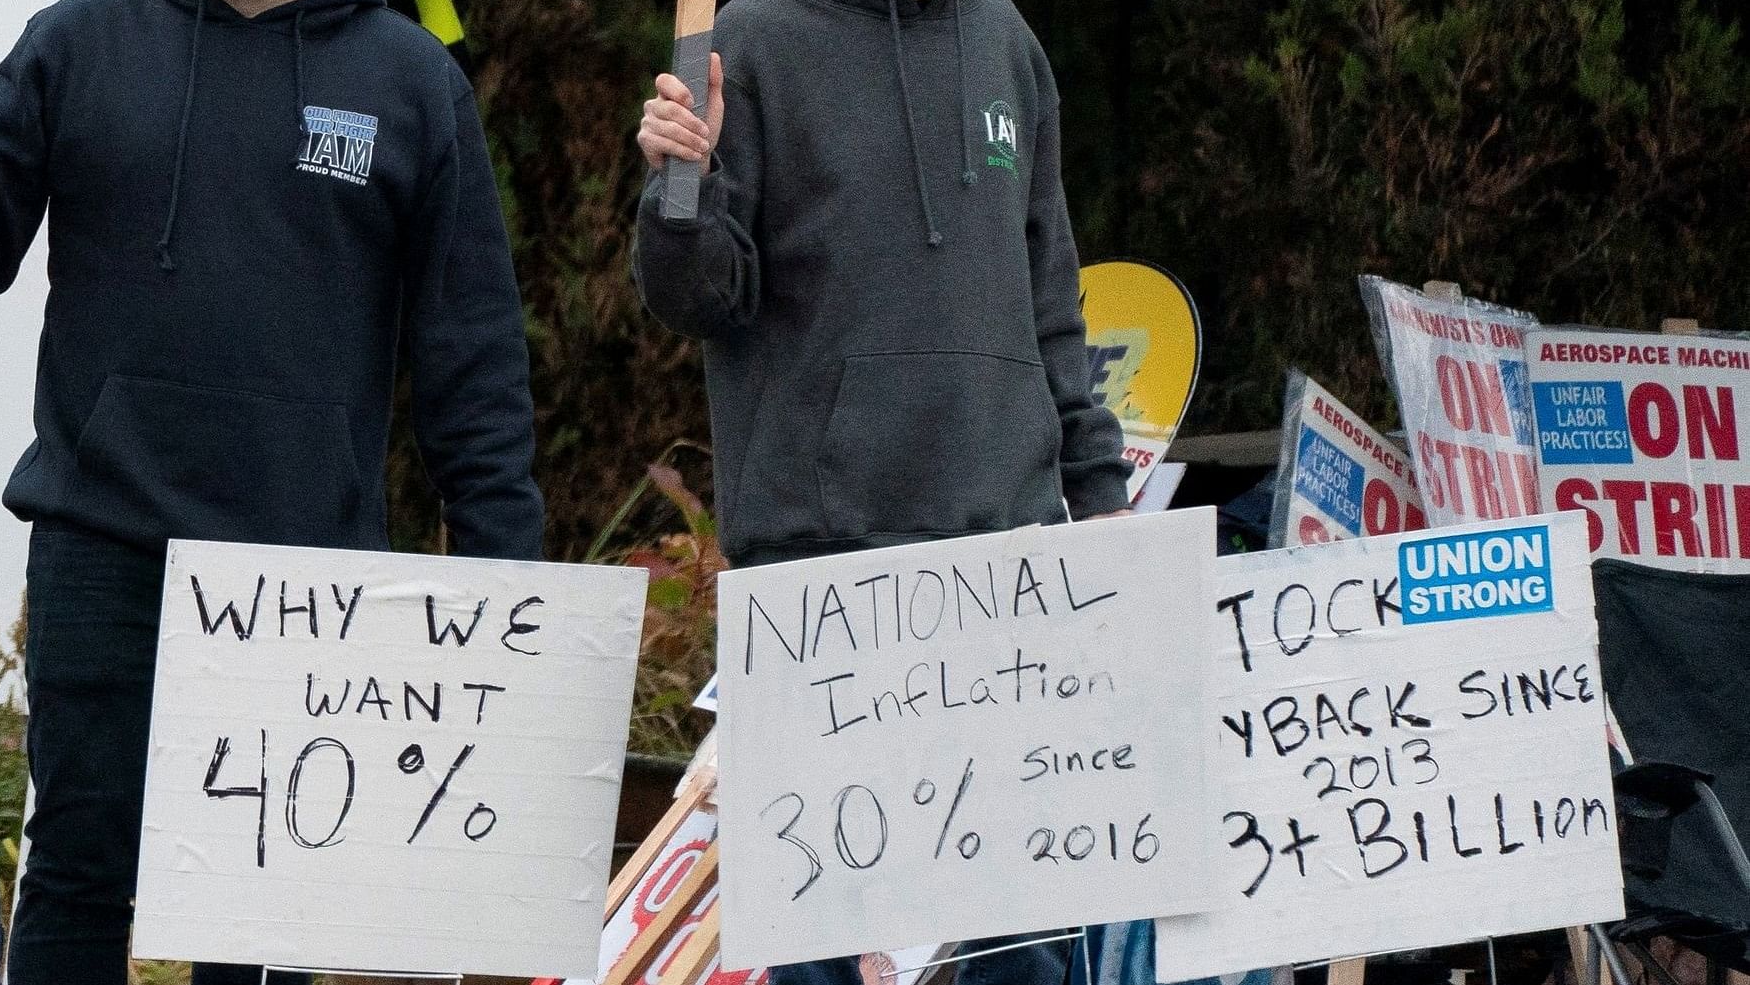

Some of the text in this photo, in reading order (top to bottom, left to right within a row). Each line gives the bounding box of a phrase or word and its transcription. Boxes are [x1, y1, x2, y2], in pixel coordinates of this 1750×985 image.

[333, 110, 378, 128] FUTURE
[336, 122, 376, 141] FIGHT
[331, 169, 368, 186] MEMBER
[1540, 343, 1671, 365] AEROSPACE
[1435, 354, 1512, 437] ON
[1551, 386, 1607, 405] UNFAIR
[1556, 408, 1607, 427] LABOR
[1627, 381, 1740, 461] ON
[1312, 396, 1404, 477] AEROSPACE
[1313, 436, 1352, 475] UNFAIR
[1540, 430, 1628, 450] PRACTICES!
[1312, 457, 1351, 495] LABOR
[1404, 534, 1545, 582] UNION
[189, 573, 545, 656] WHY WE
[744, 556, 1118, 675] NATIONAL
[1408, 577, 1547, 615] STRONG
[1216, 575, 1402, 673] TOCK
[305, 672, 507, 724] WANT
[1221, 662, 1596, 759] YBACK SINCE
[1302, 738, 1440, 800] 2013
[202, 728, 498, 869] 40%
[758, 756, 983, 902] 30%
[1027, 813, 1161, 865] 2016
